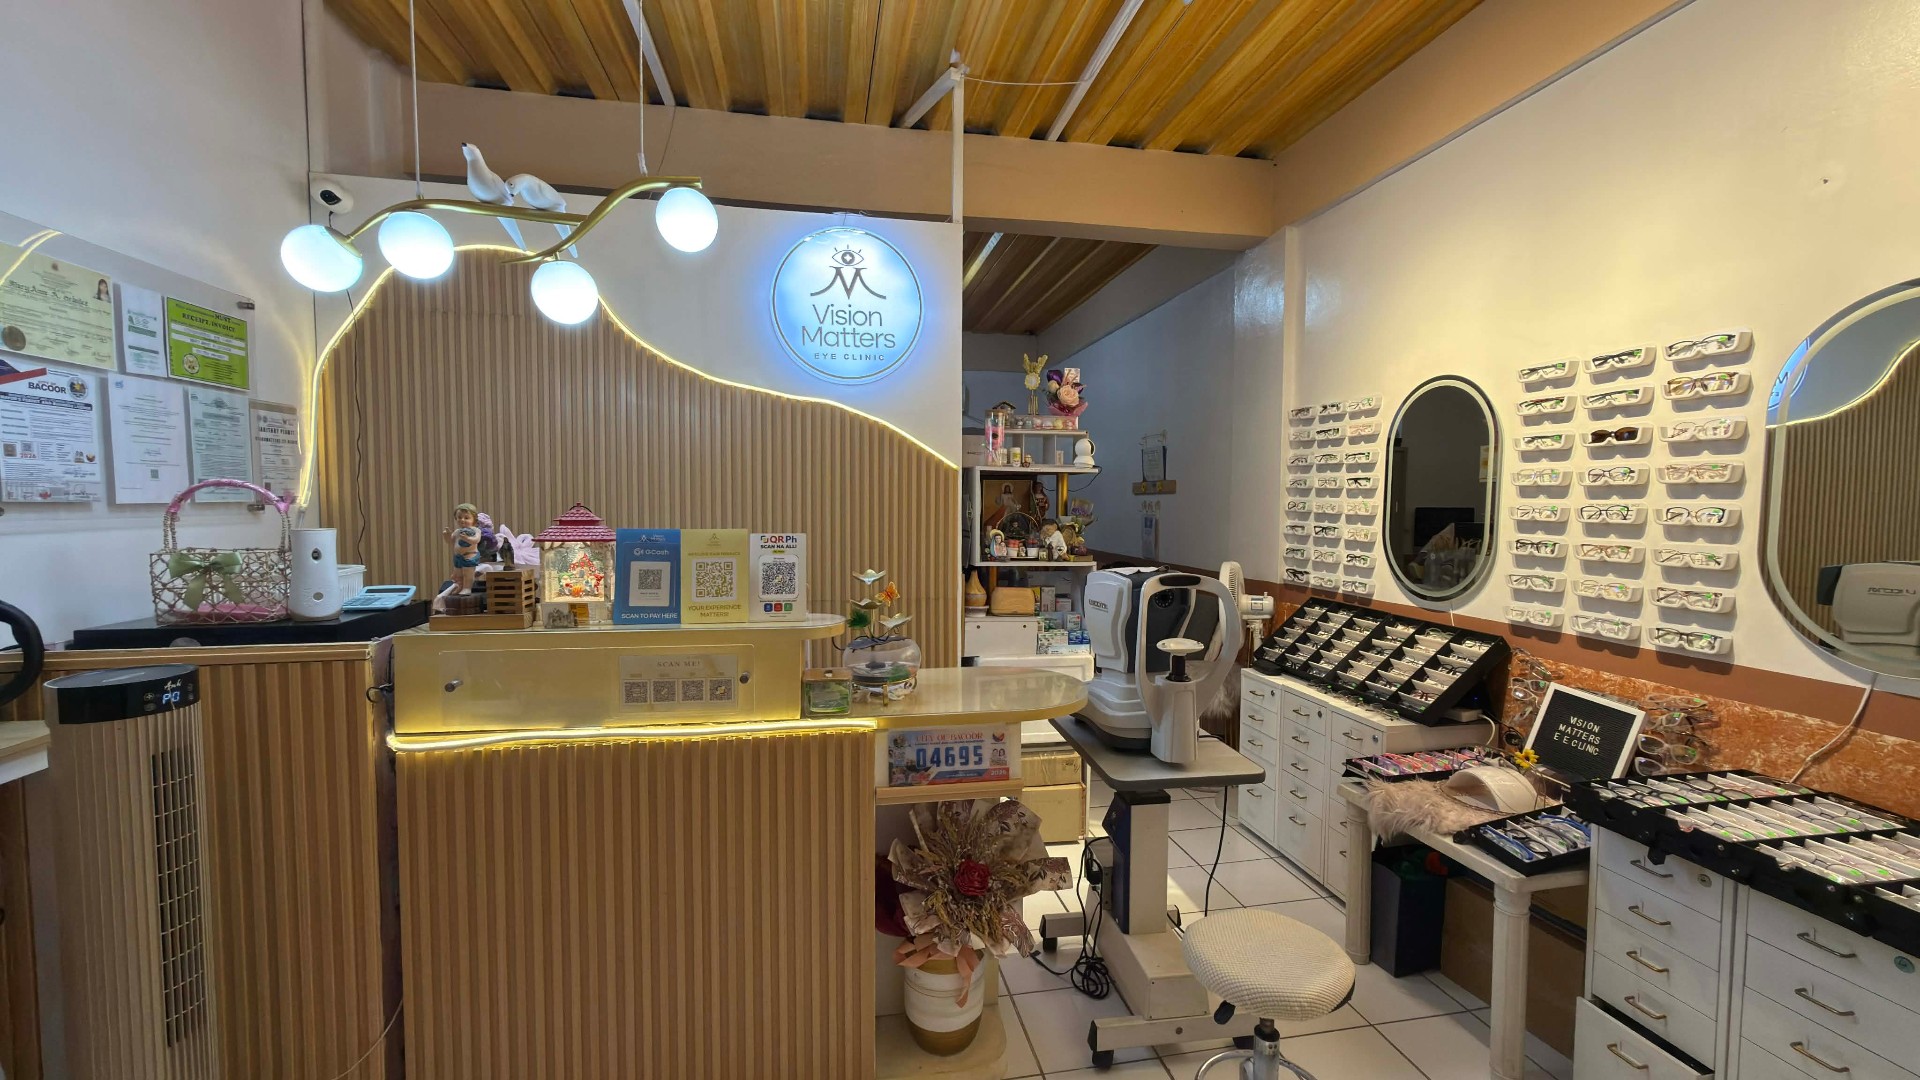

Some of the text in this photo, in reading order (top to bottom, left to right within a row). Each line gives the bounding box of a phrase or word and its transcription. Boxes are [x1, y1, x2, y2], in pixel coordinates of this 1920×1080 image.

[812, 303, 882, 327] Vision
[801, 325, 896, 348] Matters
[814, 352, 885, 361] EYE CLINIC
[28, 381, 67, 394] BACOOR
[770, 535, 797, 544] QR Ph
[1558, 723, 1601, 745] MATTERS
[1570, 716, 1600, 733] VISION
[950, 731, 984, 741] BACOOR
[1553, 732, 1560, 741] E
[1571, 739, 1599, 756] CLINIC
[916, 745, 983, 769] 04695
